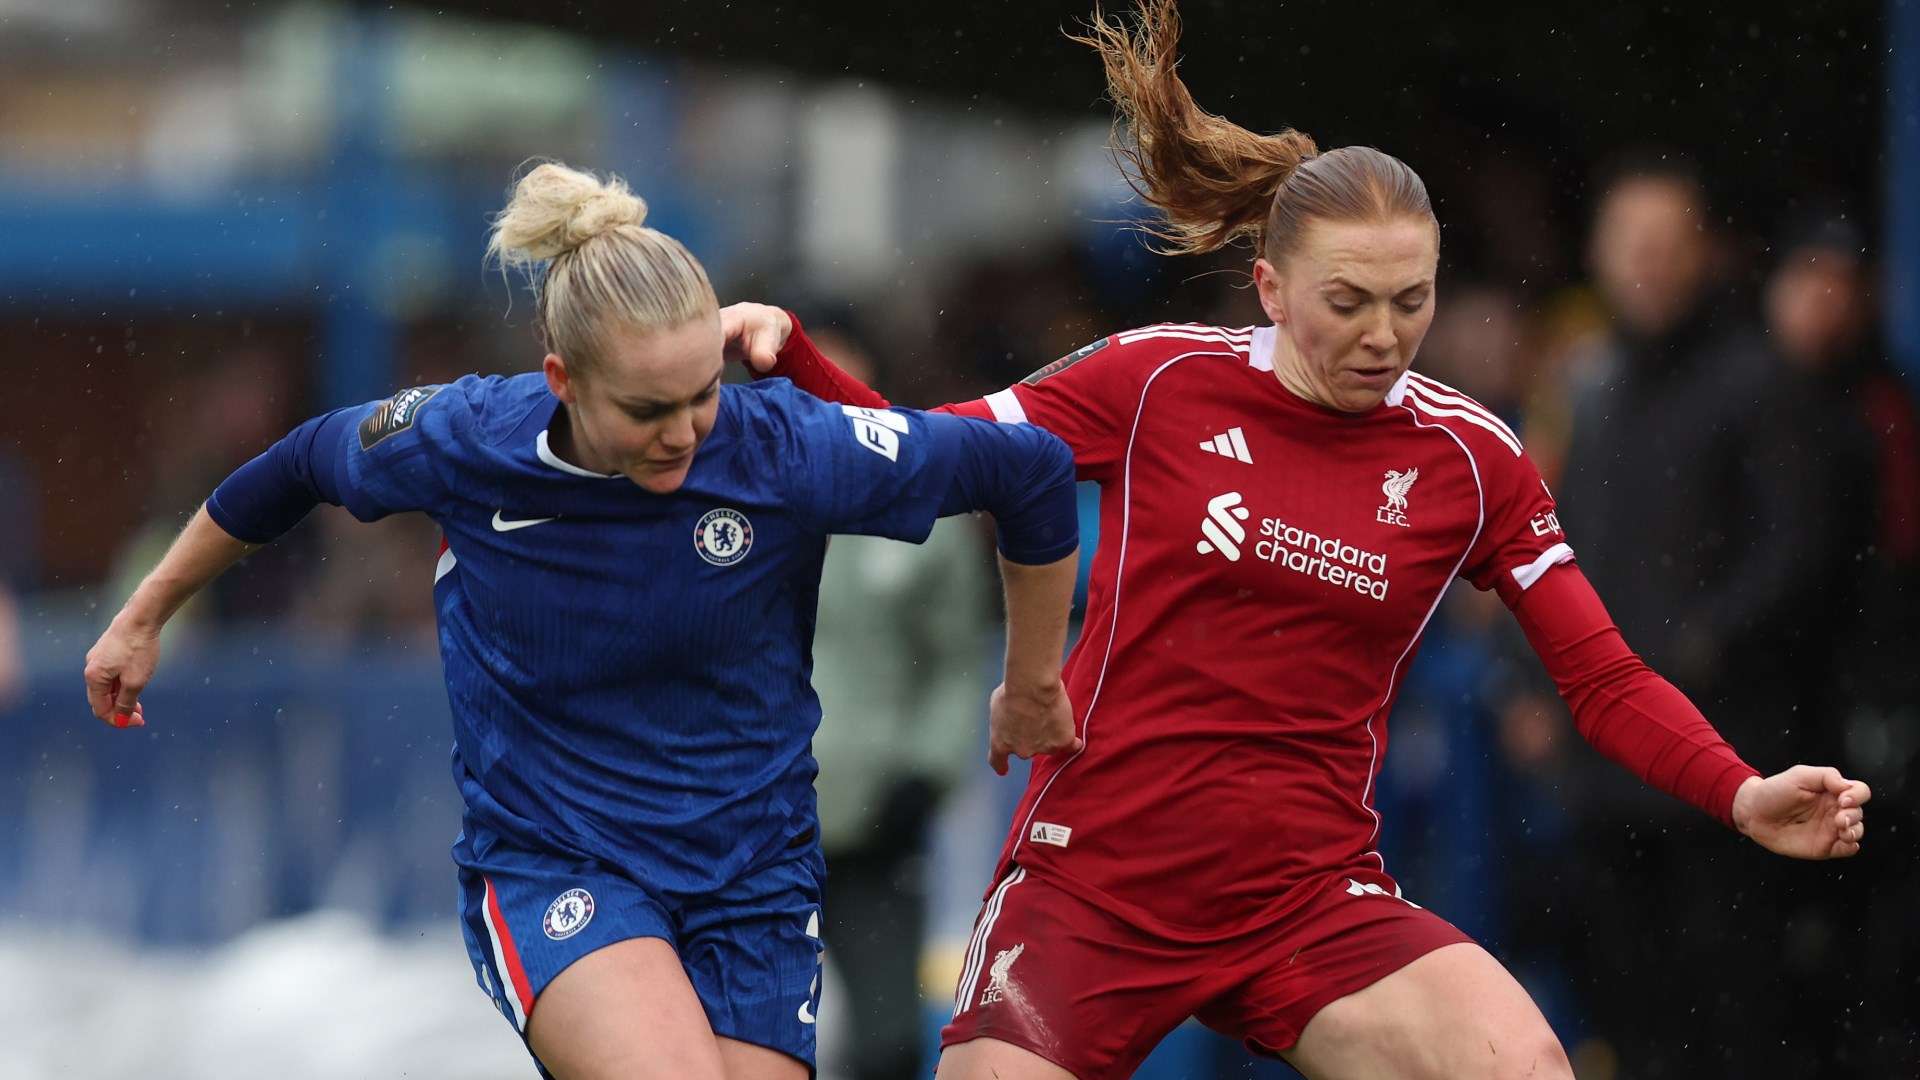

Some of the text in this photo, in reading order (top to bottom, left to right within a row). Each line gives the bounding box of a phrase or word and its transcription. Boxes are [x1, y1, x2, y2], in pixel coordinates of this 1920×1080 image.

[703, 510, 741, 524] CHELSEA
[1259, 517, 1387, 576] standard
[1255, 540, 1389, 601] chartered
